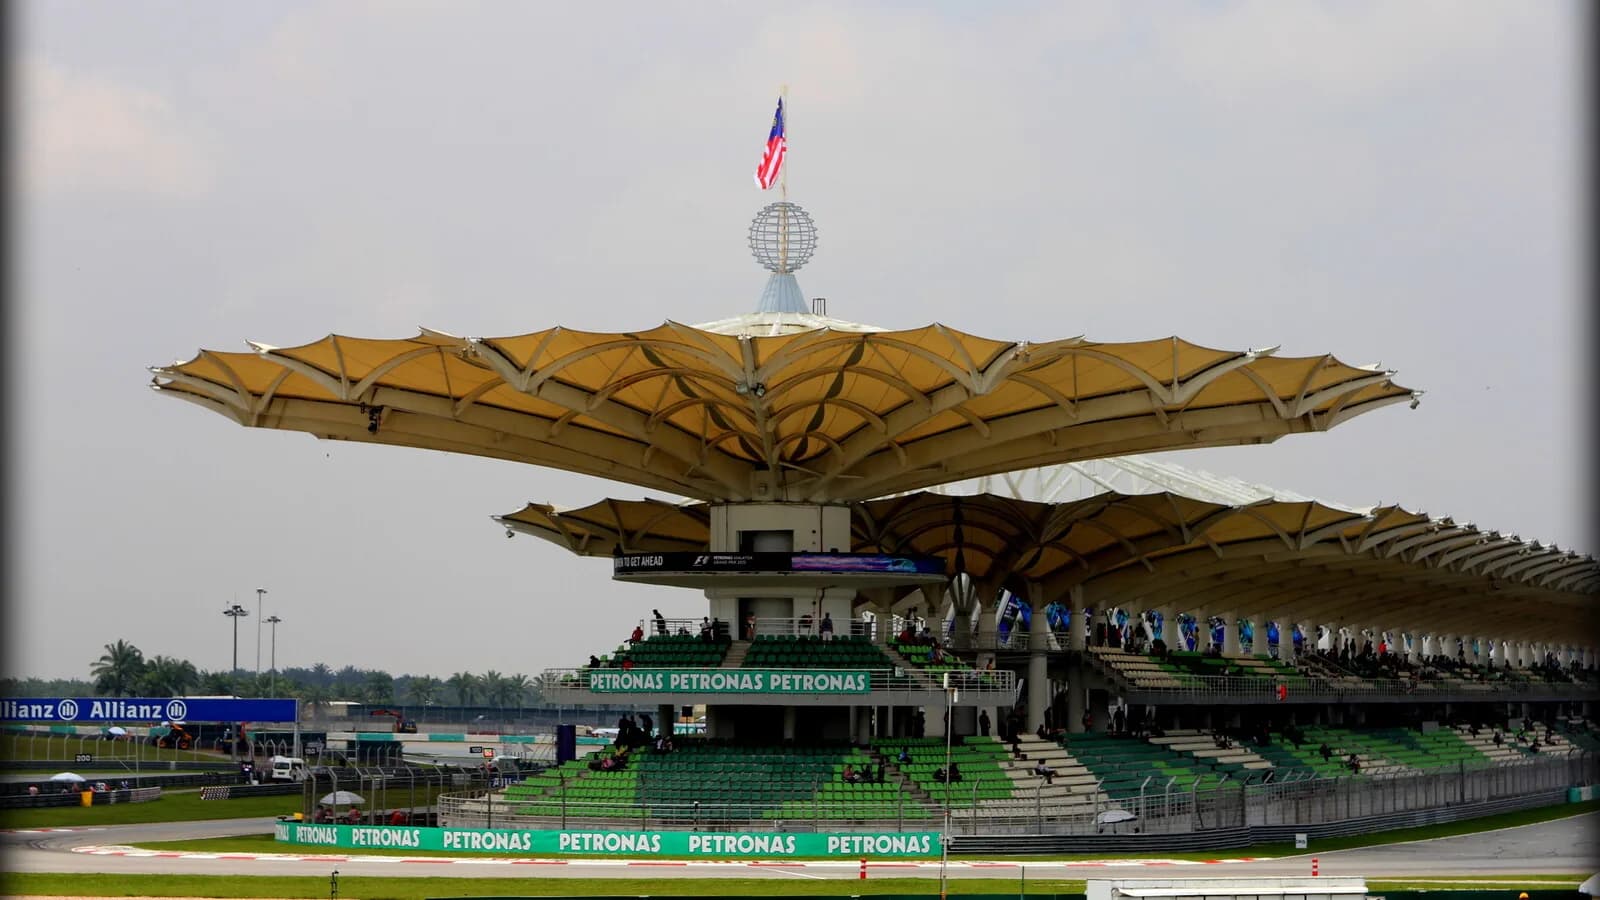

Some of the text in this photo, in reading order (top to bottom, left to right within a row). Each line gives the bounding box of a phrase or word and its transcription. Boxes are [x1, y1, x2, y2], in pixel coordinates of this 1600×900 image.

[630, 556, 640, 567] GET
[641, 555, 664, 567] AHEAD
[590, 672, 866, 690] PETRONAS PETRONAS PETRONAS
[91, 701, 162, 718] Allianz
[296, 826, 337, 844] PETRONAS
[352, 828, 420, 847] PETRONAS
[443, 832, 531, 850] PETRONAS
[559, 834, 661, 852] PETRONAS
[688, 835, 796, 853] PETRONAS
[827, 835, 930, 853] PETRONAS
